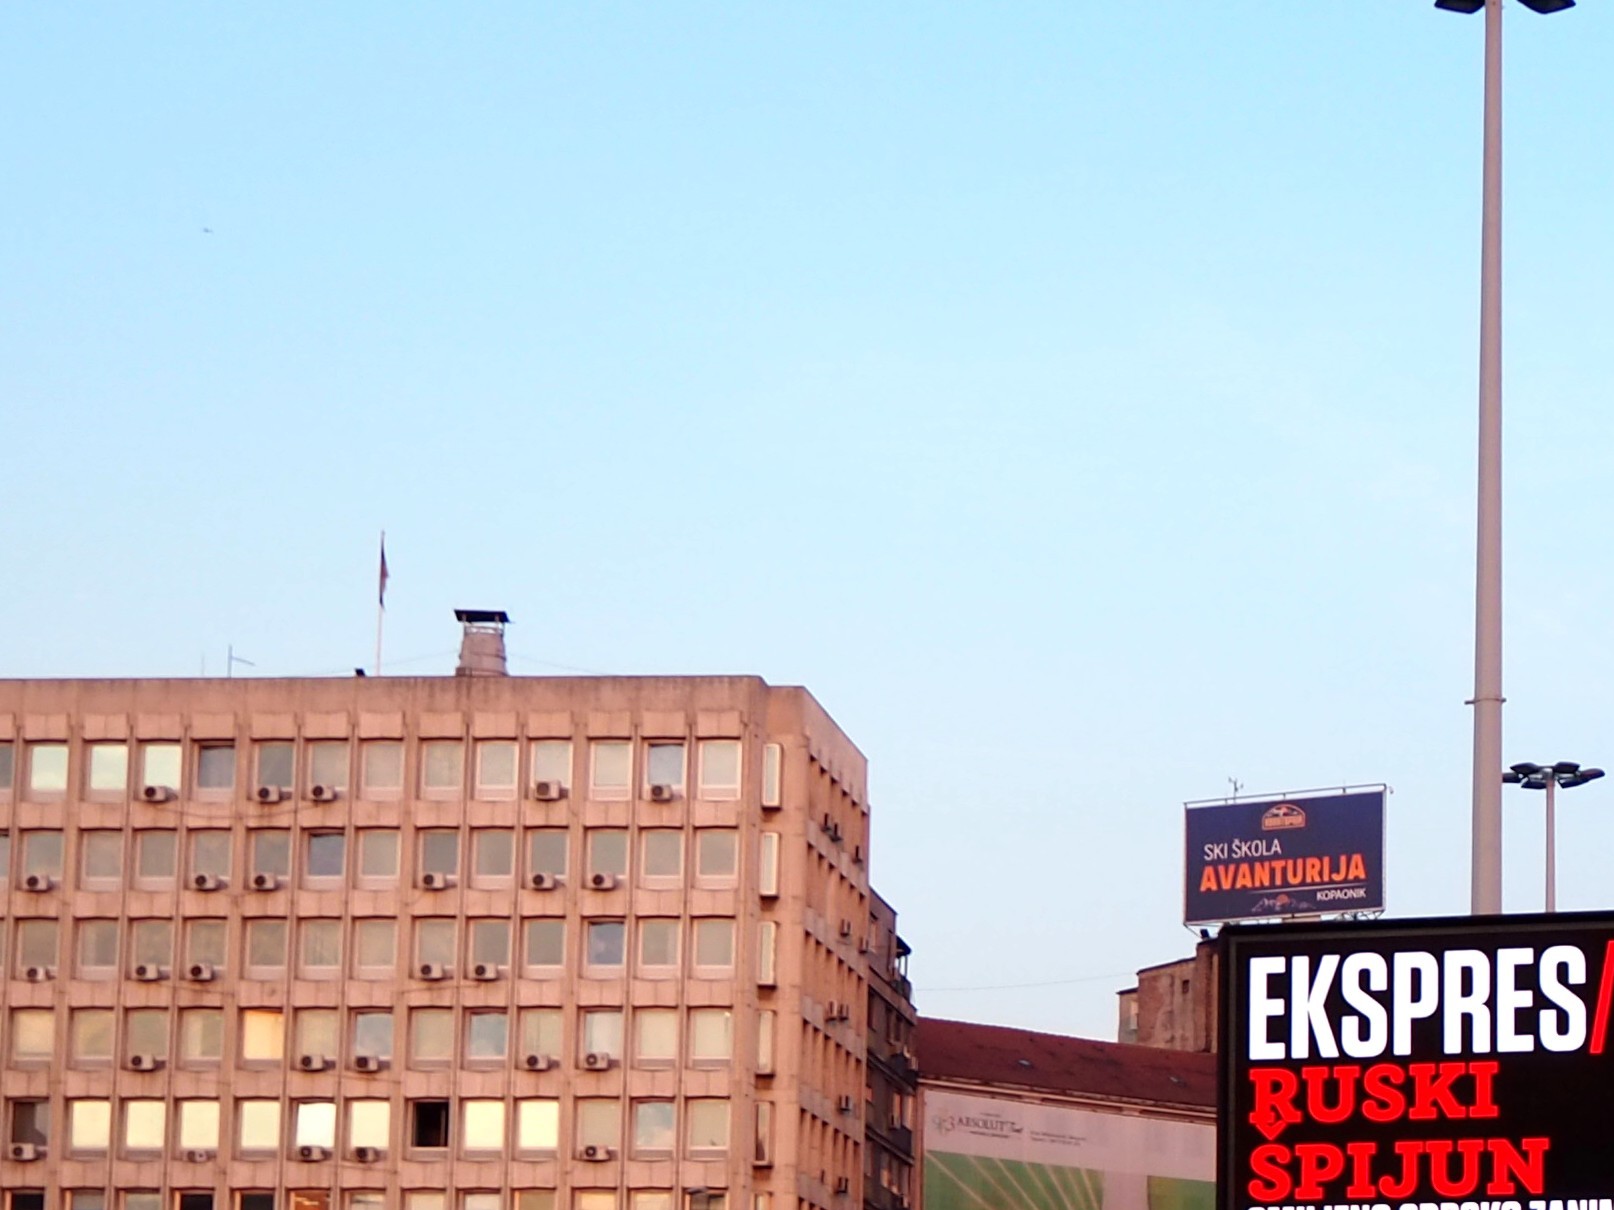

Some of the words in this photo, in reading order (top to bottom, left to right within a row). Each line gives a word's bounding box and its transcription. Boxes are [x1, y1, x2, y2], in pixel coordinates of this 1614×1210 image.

[1204, 843, 1228, 861] SKI
[1232, 838, 1282, 860] ŠKOLA
[1200, 853, 1366, 892] AVANTURIJA
[1316, 887, 1367, 902] KOPAONIK
[1248, 1060, 1500, 1128] RUSKI
[1247, 1122, 1551, 1202] ŠPIJUN
